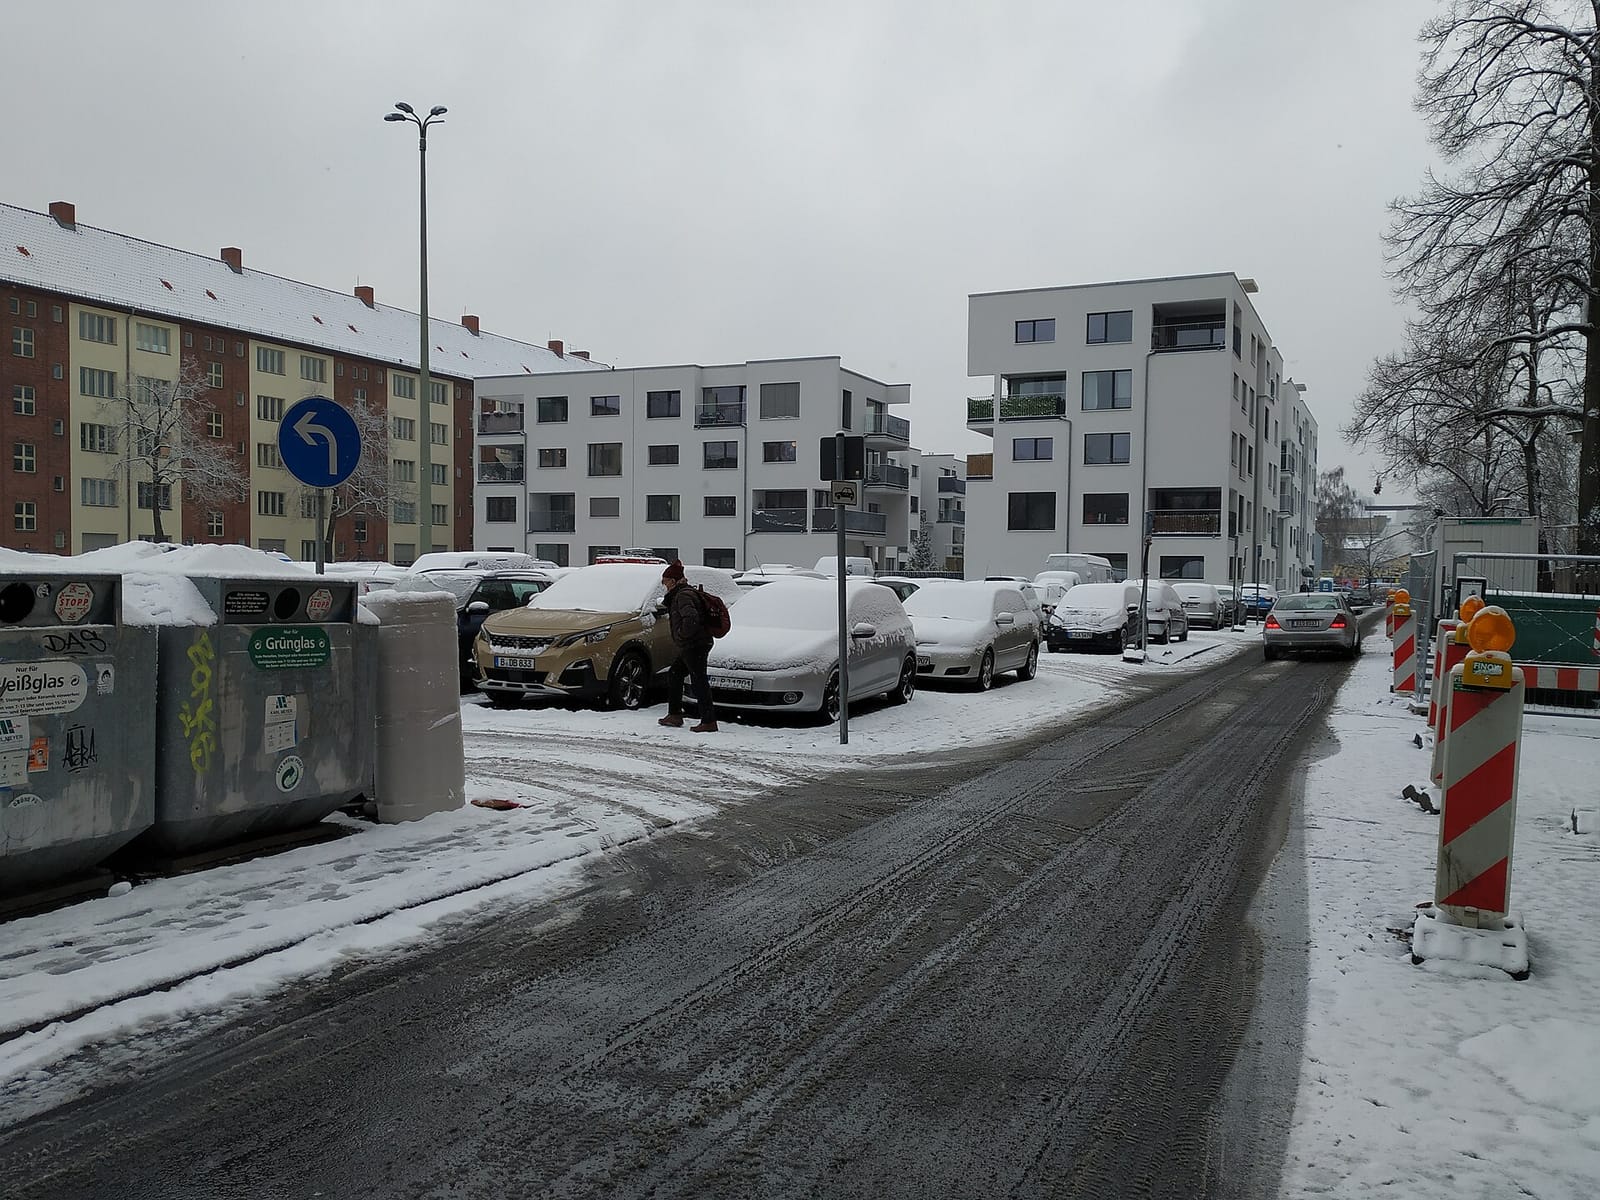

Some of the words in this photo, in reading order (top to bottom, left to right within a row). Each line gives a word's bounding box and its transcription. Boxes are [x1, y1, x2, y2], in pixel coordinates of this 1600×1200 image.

[59, 598, 89, 607] STOPP
[310, 600, 330, 608] STOPP
[42, 630, 107, 652] DAS
[266, 635, 315, 652] Grünglas
